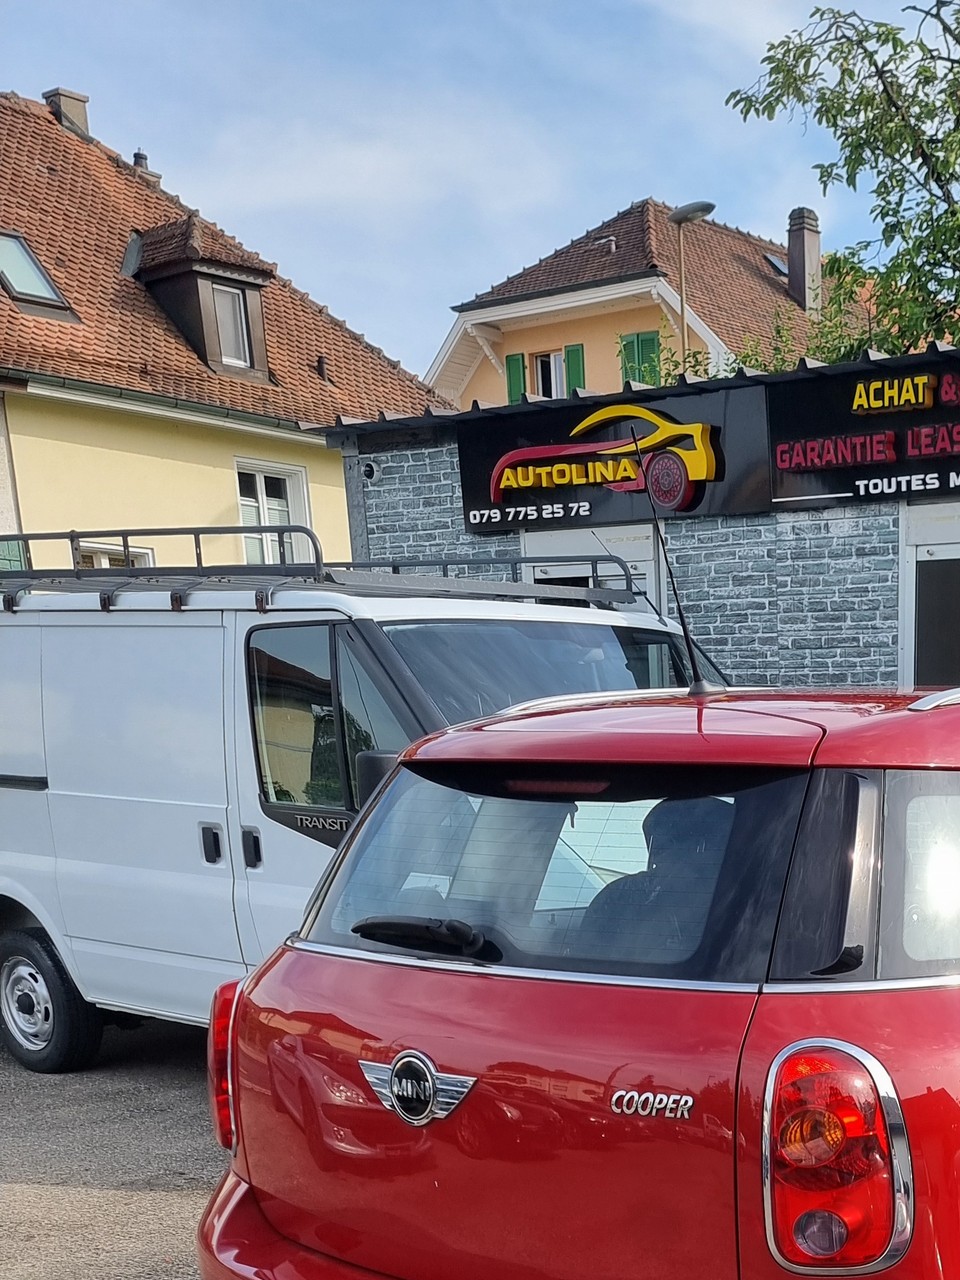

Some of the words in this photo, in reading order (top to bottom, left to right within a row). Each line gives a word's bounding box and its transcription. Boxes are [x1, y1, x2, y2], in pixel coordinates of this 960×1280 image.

[852, 375, 932, 411] ACHAT
[776, 434, 890, 470] GARANTIE
[500, 458, 640, 489] AUTOLINA
[855, 473, 940, 496] TOUTES
[469, 508, 501, 524] 079
[505, 506, 538, 522] 775
[542, 503, 564, 519] 25
[568, 501, 591, 517] 72
[295, 815, 348, 831] TRANSIT
[393, 1077, 431, 1100] MINI
[611, 1090, 694, 1119] COOPER
